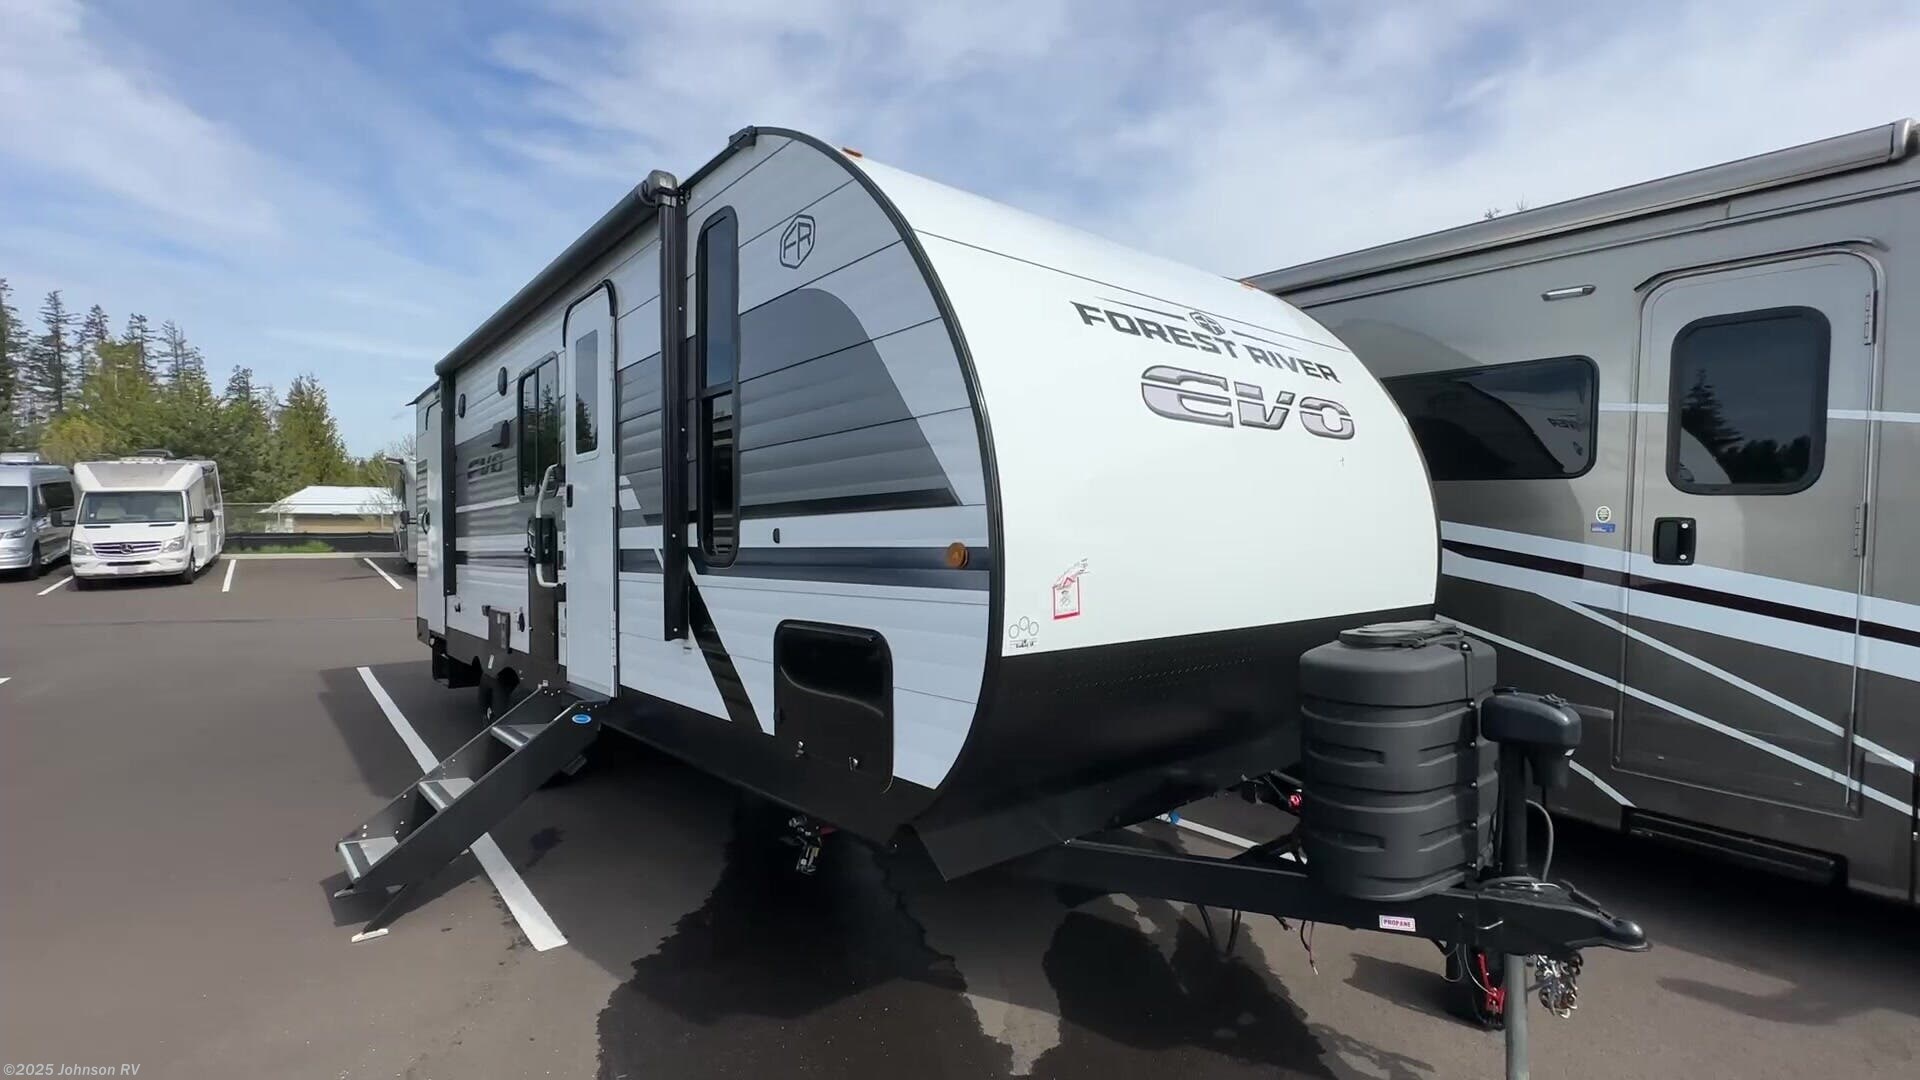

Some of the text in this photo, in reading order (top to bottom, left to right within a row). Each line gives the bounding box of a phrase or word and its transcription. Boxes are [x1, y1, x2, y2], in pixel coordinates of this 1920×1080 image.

[1071, 301, 1239, 359] FOREST
[1244, 345, 1342, 384] RIVER
[1140, 365, 1355, 440] EVO
[1383, 919, 1411, 928] PROPANE
